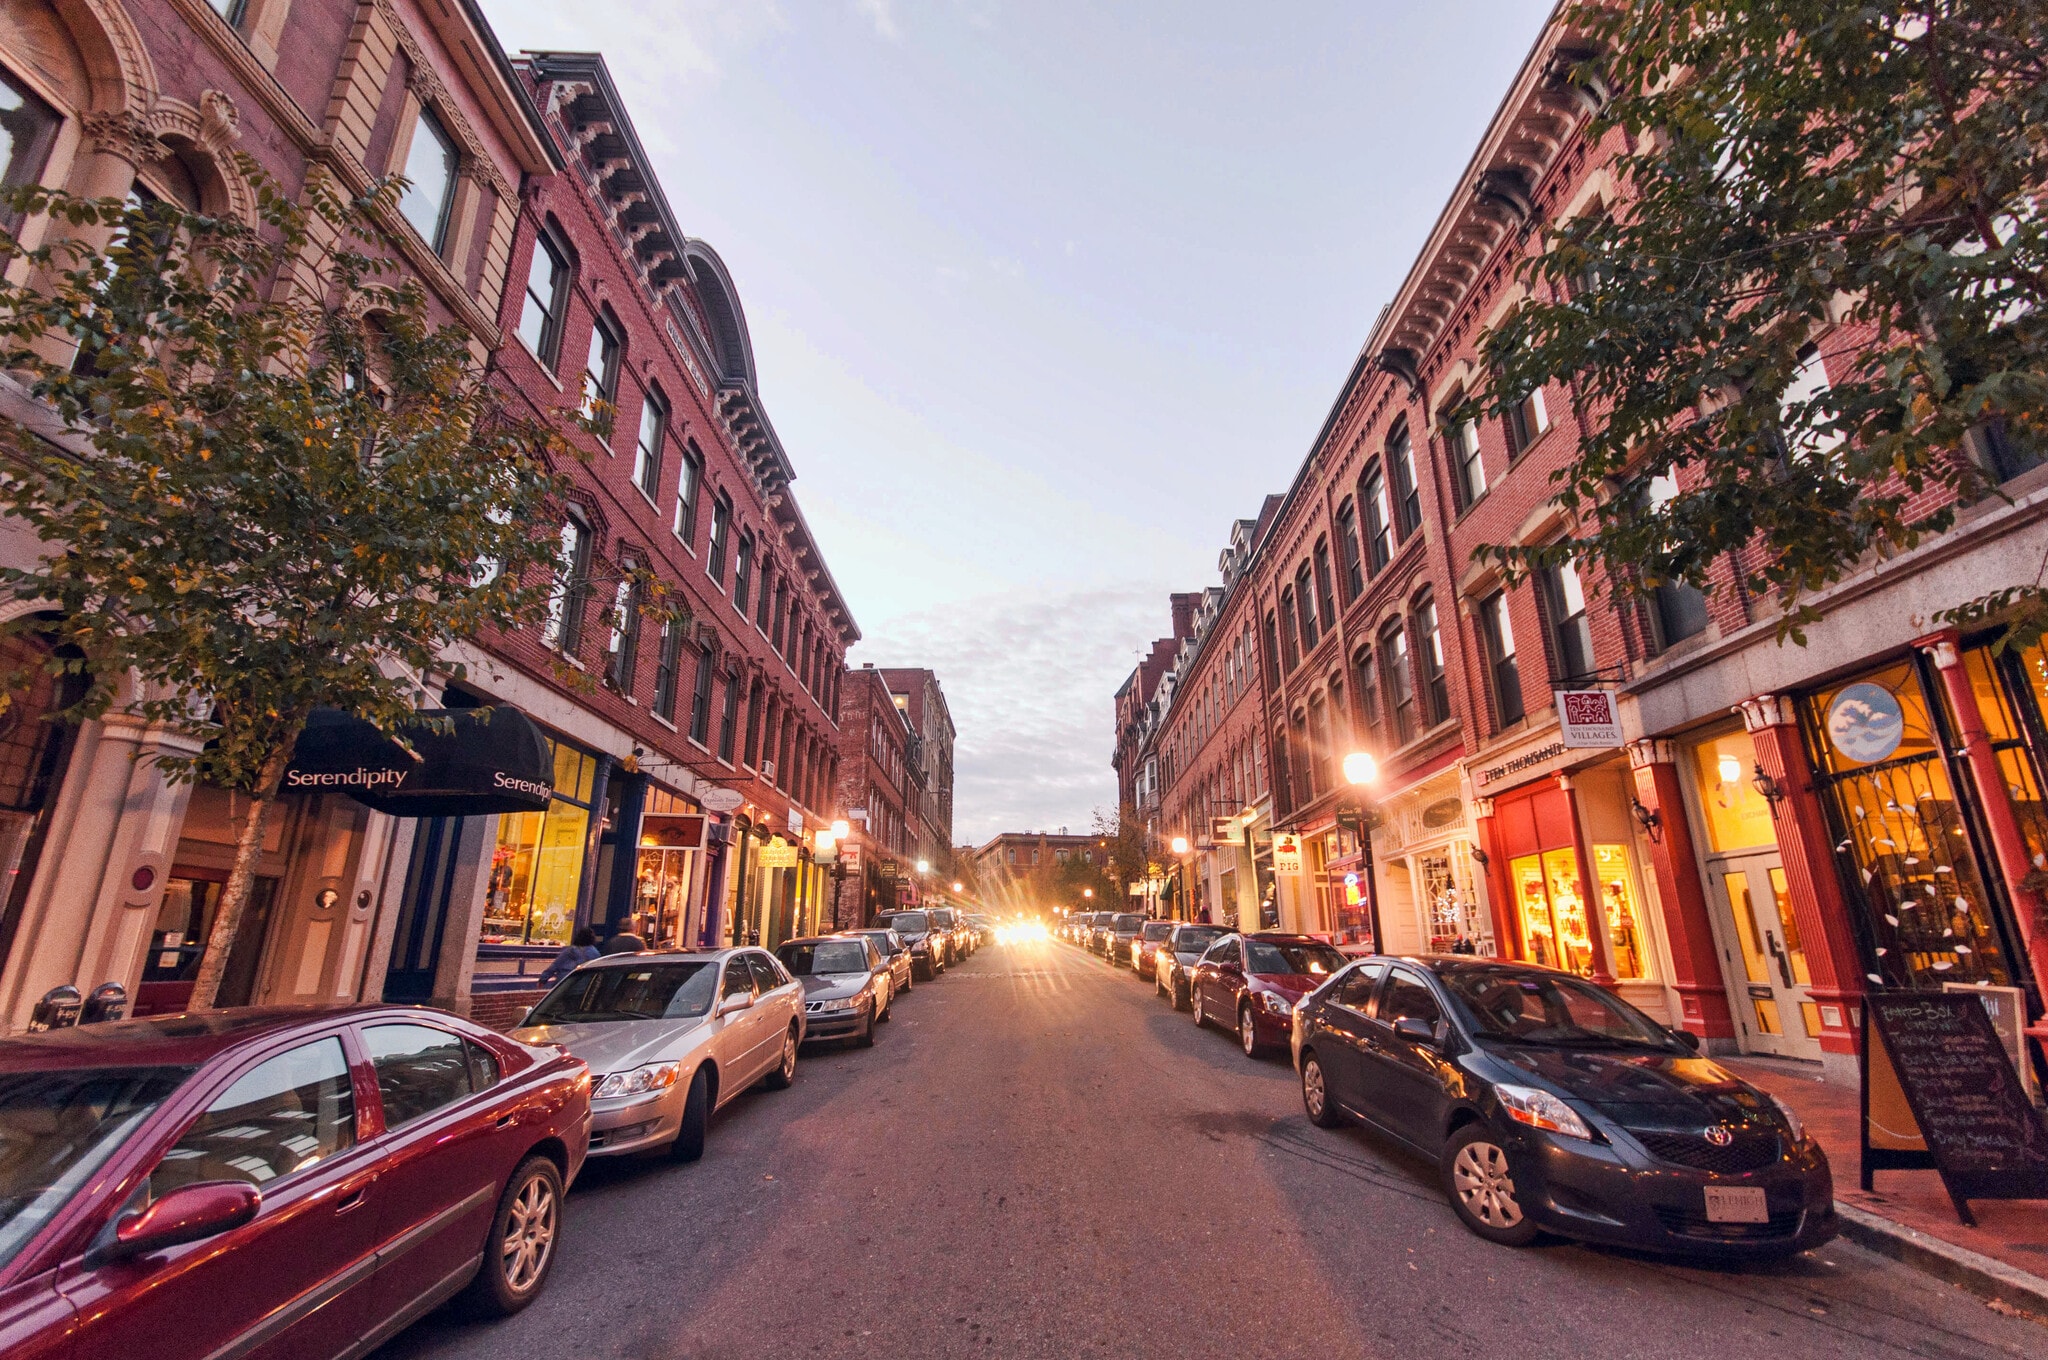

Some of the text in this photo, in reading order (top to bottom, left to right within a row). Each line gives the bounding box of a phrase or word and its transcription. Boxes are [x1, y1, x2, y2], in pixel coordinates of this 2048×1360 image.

[1487, 743, 1563, 781] TEN THOUSAND
[287, 767, 551, 802] Serendipity Serendipi
[1280, 862, 1299, 871] PIG
